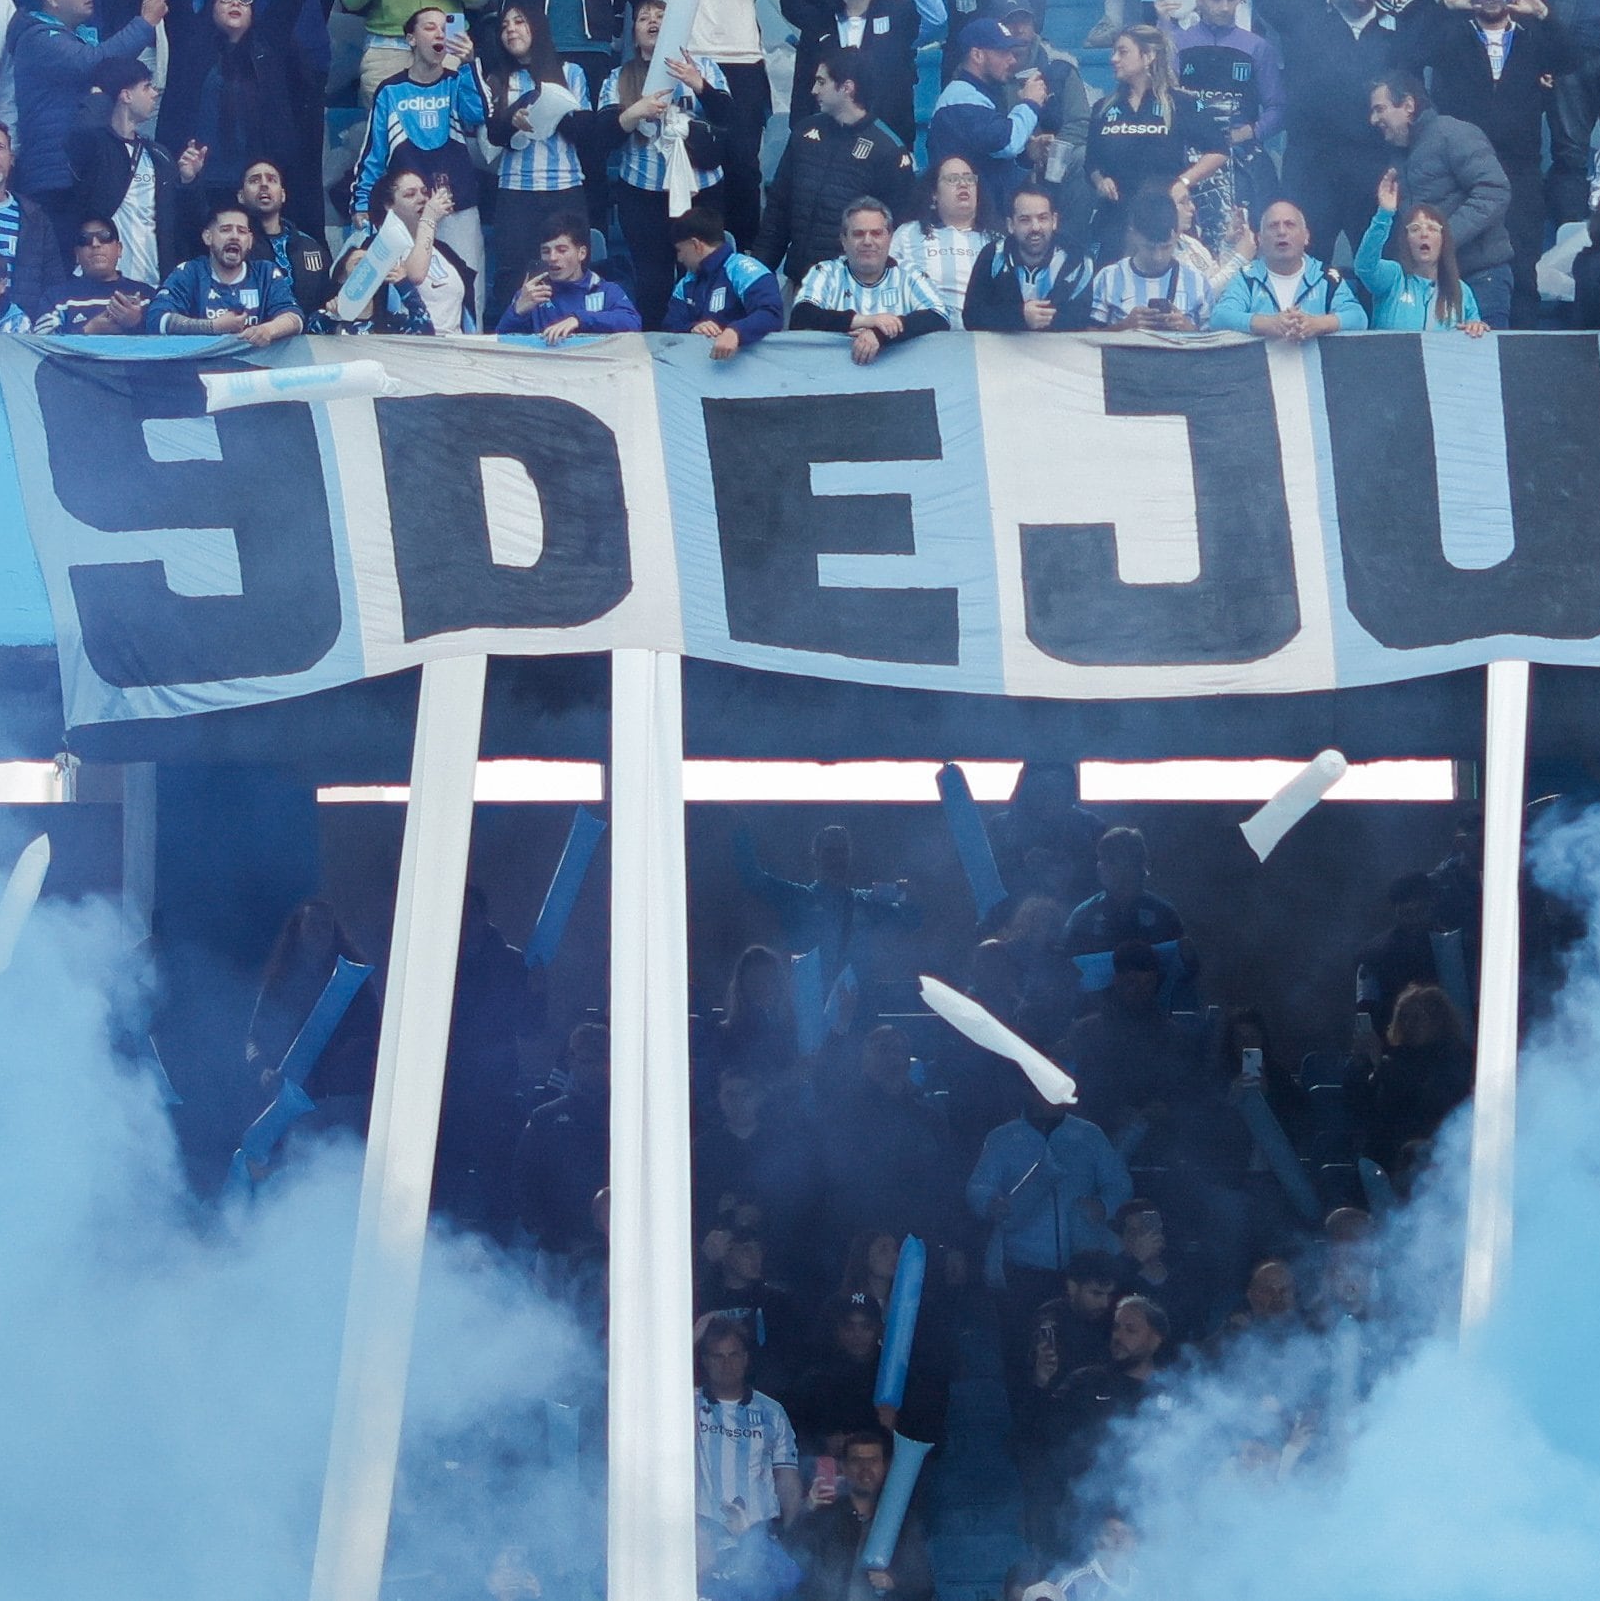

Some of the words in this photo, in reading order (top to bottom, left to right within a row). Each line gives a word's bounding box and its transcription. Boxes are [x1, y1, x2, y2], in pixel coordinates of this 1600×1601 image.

[398, 94, 450, 111] adidas
[1101, 122, 1168, 136] betsson
[373, 387, 961, 667] DE
[700, 1422, 763, 1439] betsson
